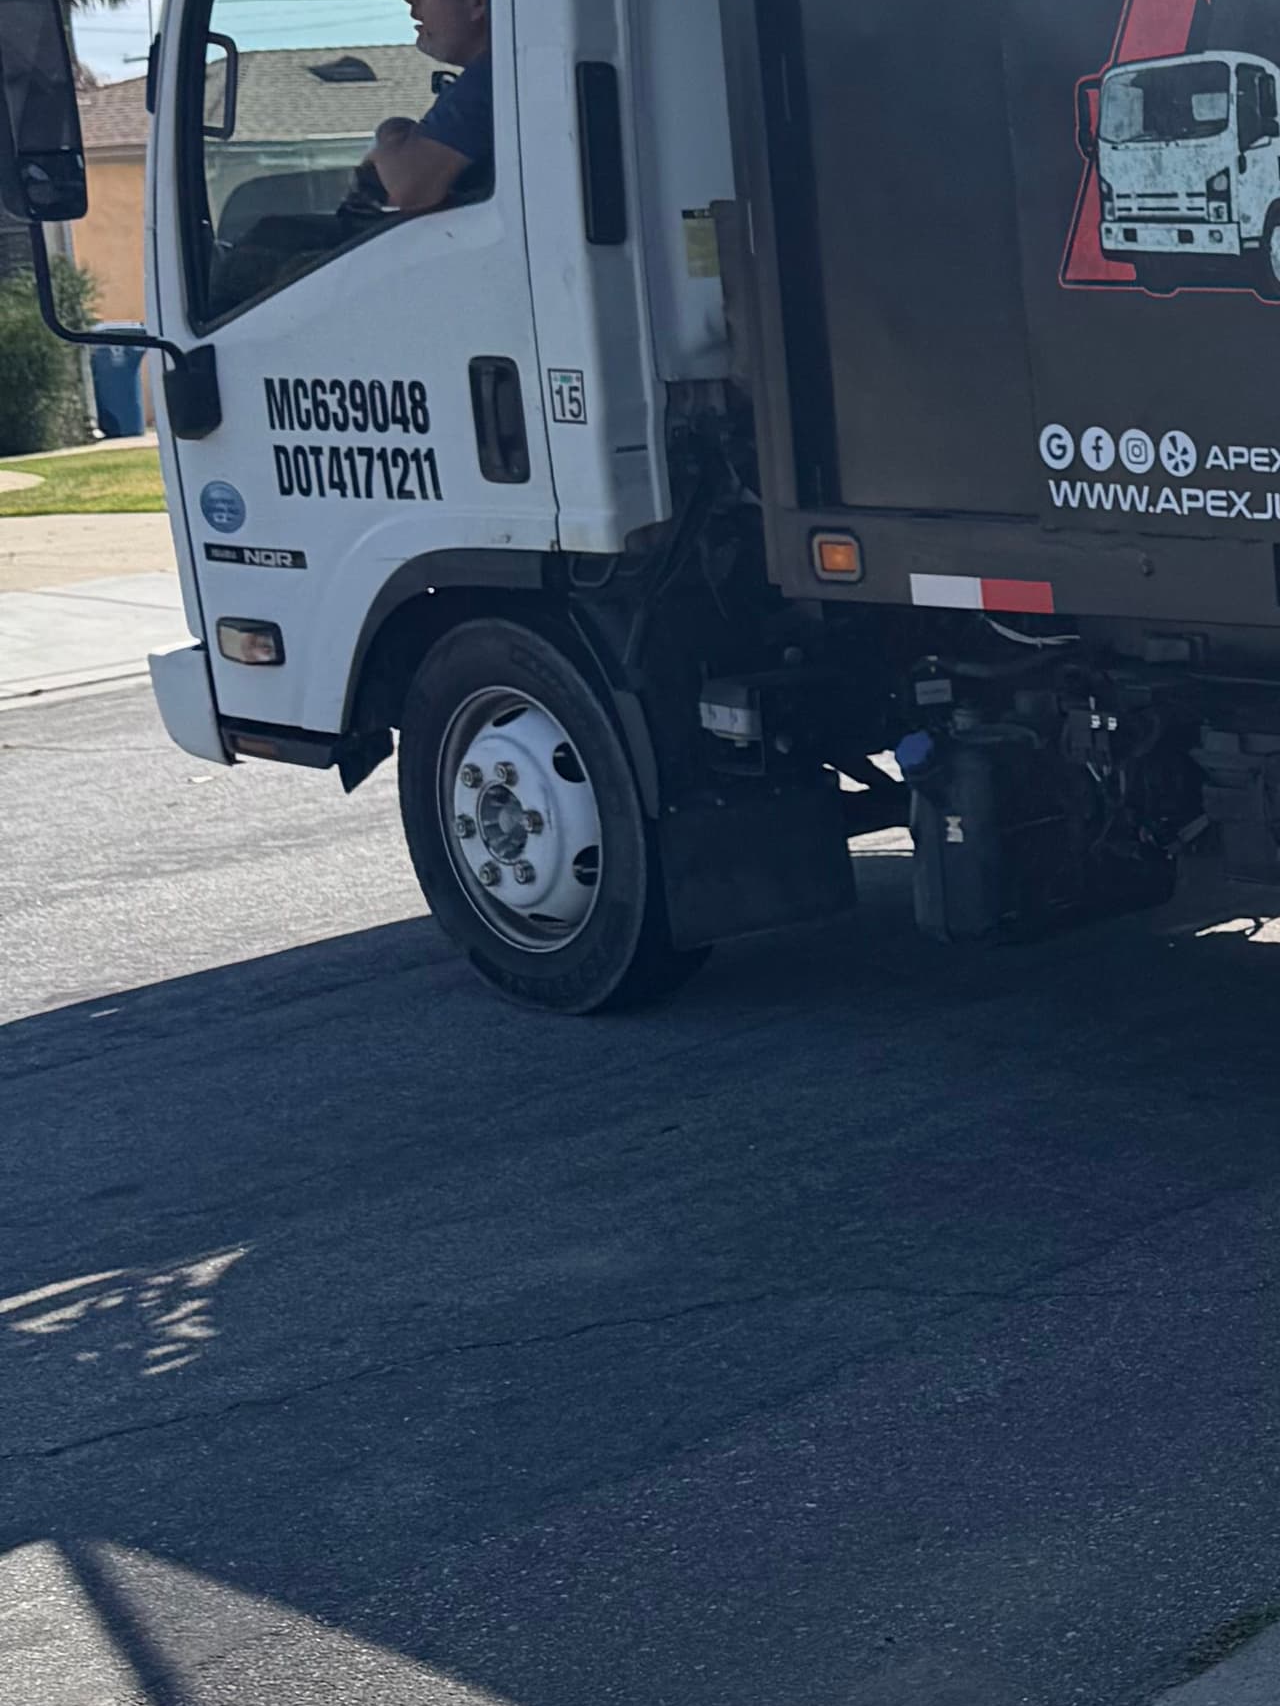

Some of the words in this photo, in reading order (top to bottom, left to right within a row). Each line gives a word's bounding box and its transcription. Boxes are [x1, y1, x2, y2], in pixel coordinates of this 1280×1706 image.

[264, 377, 430, 435] MC639048
[554, 384, 582, 419] 15
[273, 444, 444, 501] DOT4171211
